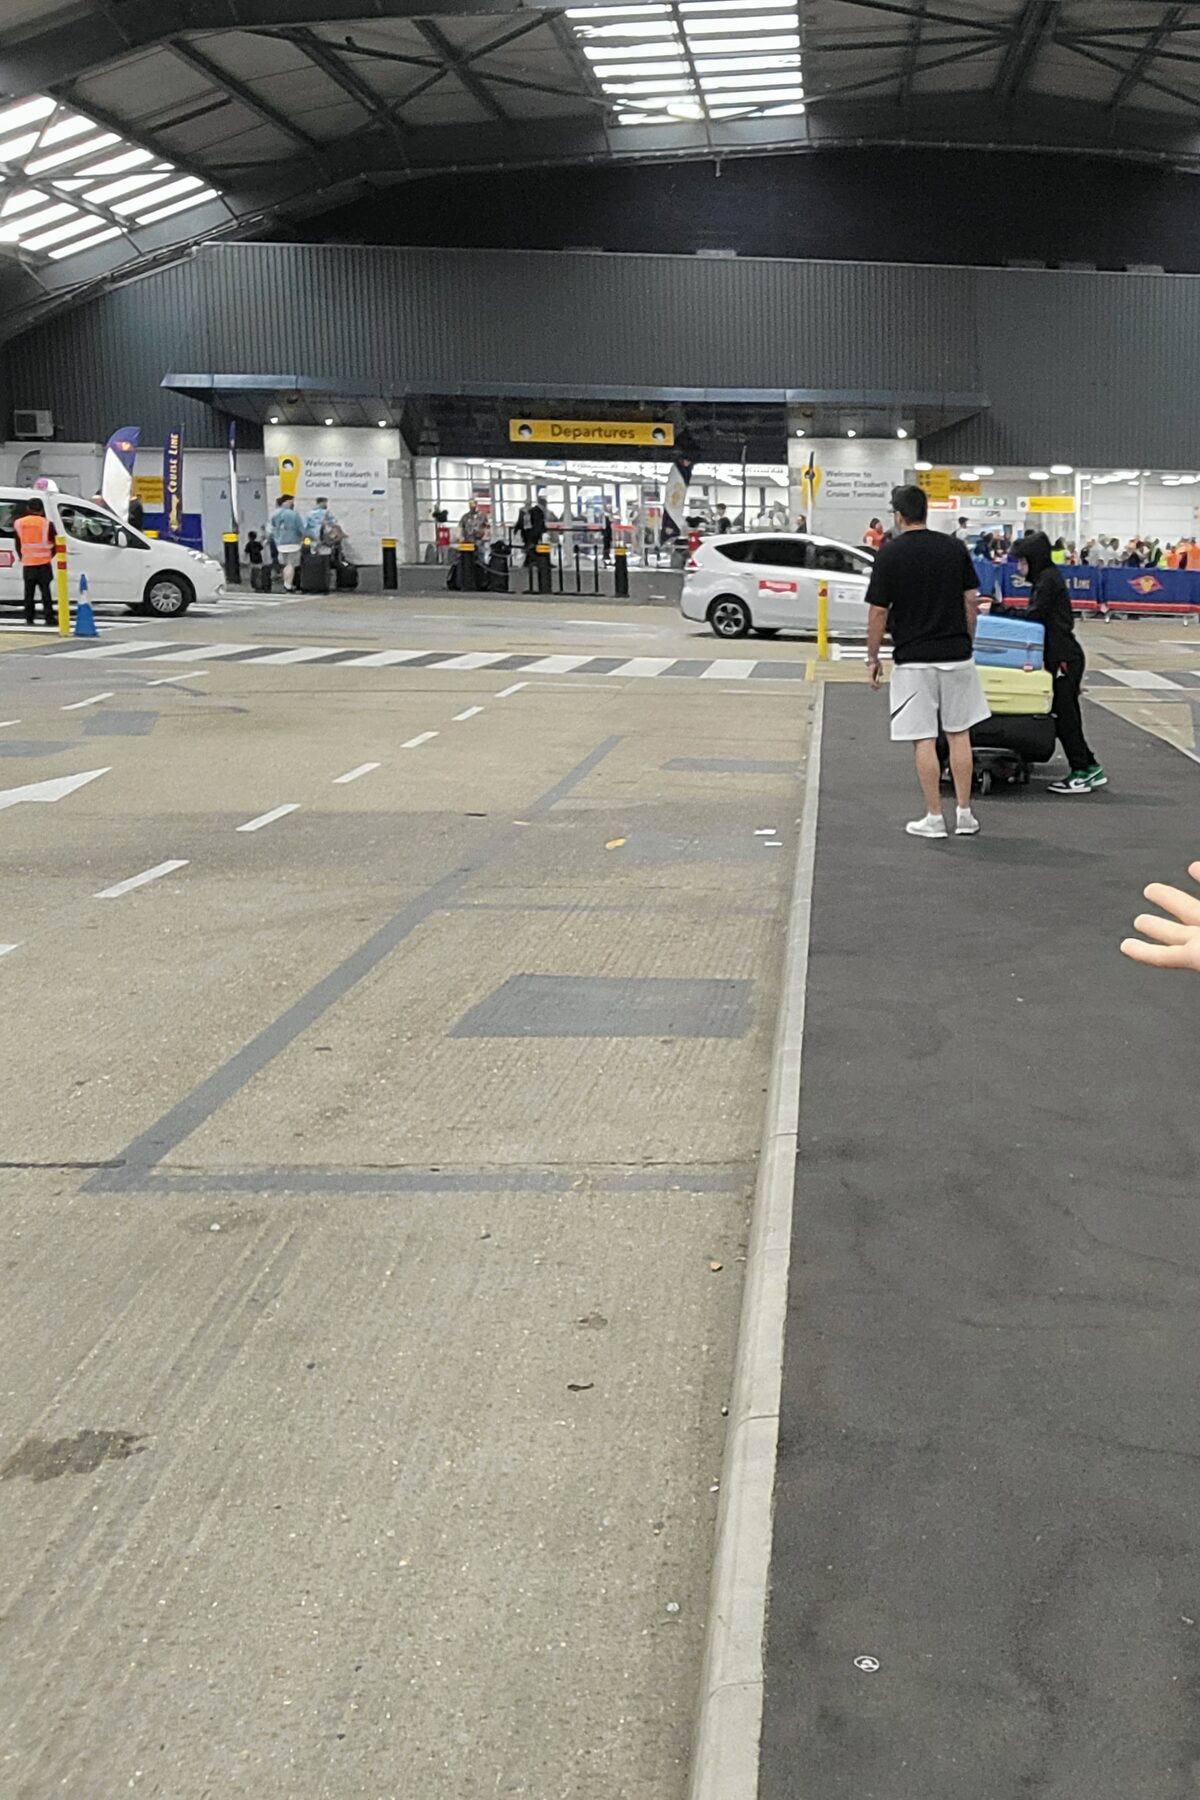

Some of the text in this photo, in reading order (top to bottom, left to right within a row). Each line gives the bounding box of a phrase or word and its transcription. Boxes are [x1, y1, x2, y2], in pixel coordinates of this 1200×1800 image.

[551, 423, 636, 441] Departures
[304, 460, 354, 468] Welcome to
[304, 470, 332, 478] Queen
[335, 470, 371, 478] Elizabeth
[825, 470, 862, 478] Welcome
[304, 480, 369, 489] Cruise Terminal
[825, 480, 852, 488] Queen
[825, 490, 886, 498] Cruise Terminal
